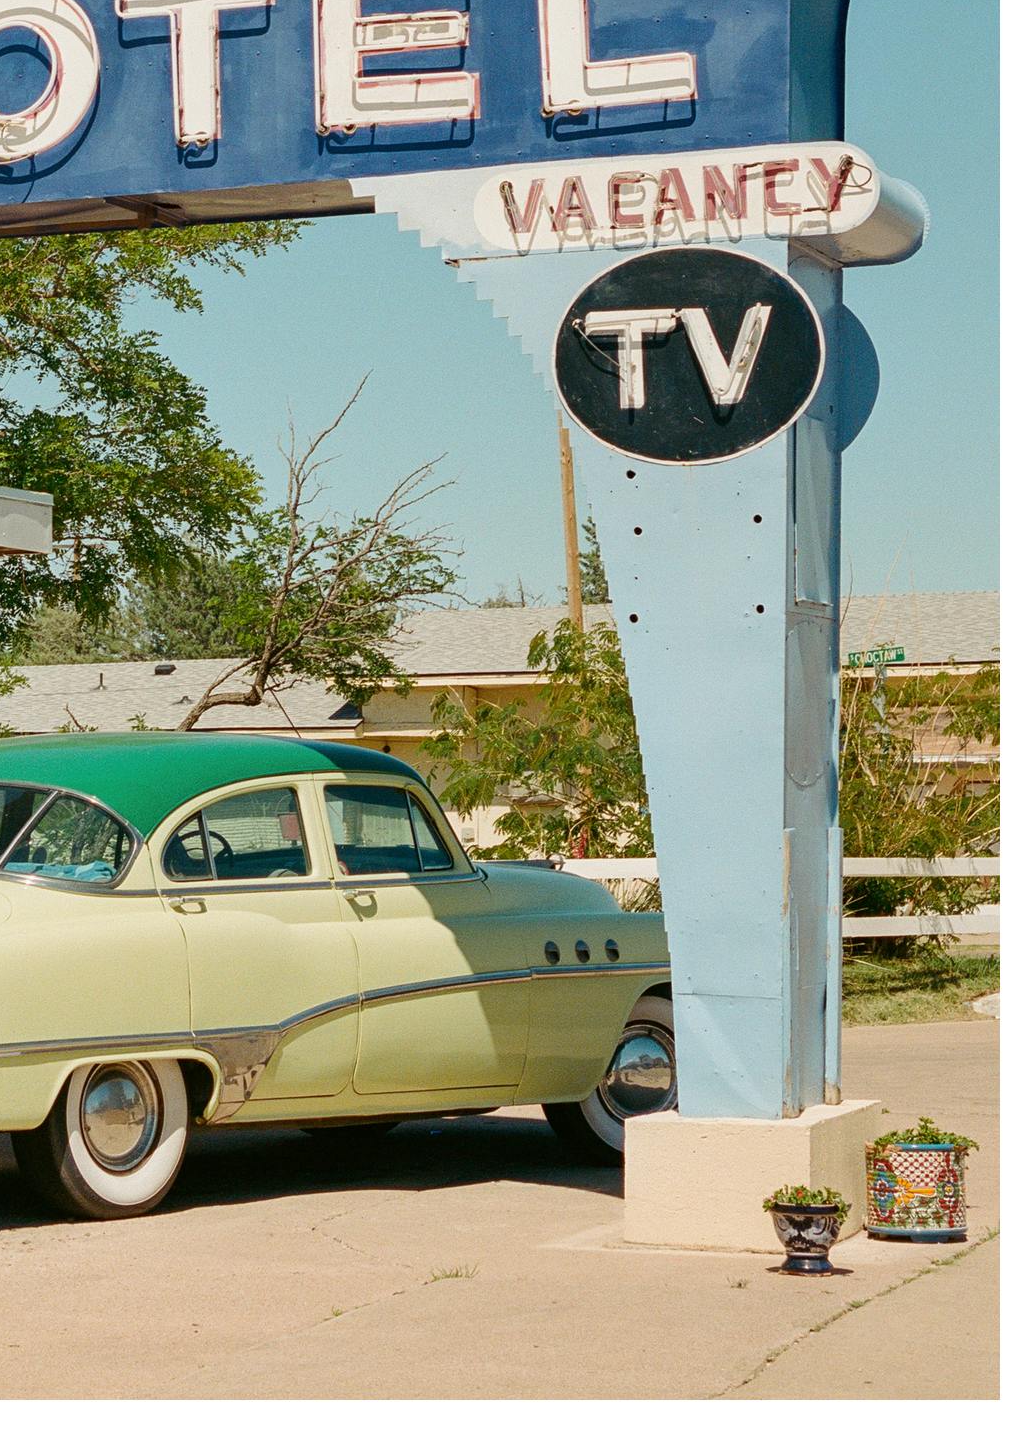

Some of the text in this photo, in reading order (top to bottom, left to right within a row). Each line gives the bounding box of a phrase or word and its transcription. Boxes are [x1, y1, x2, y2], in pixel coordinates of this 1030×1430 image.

[499, 155, 855, 234] VACANCY
[576, 303, 773, 410] TV
[855, 650, 897, 664] COCTAW
